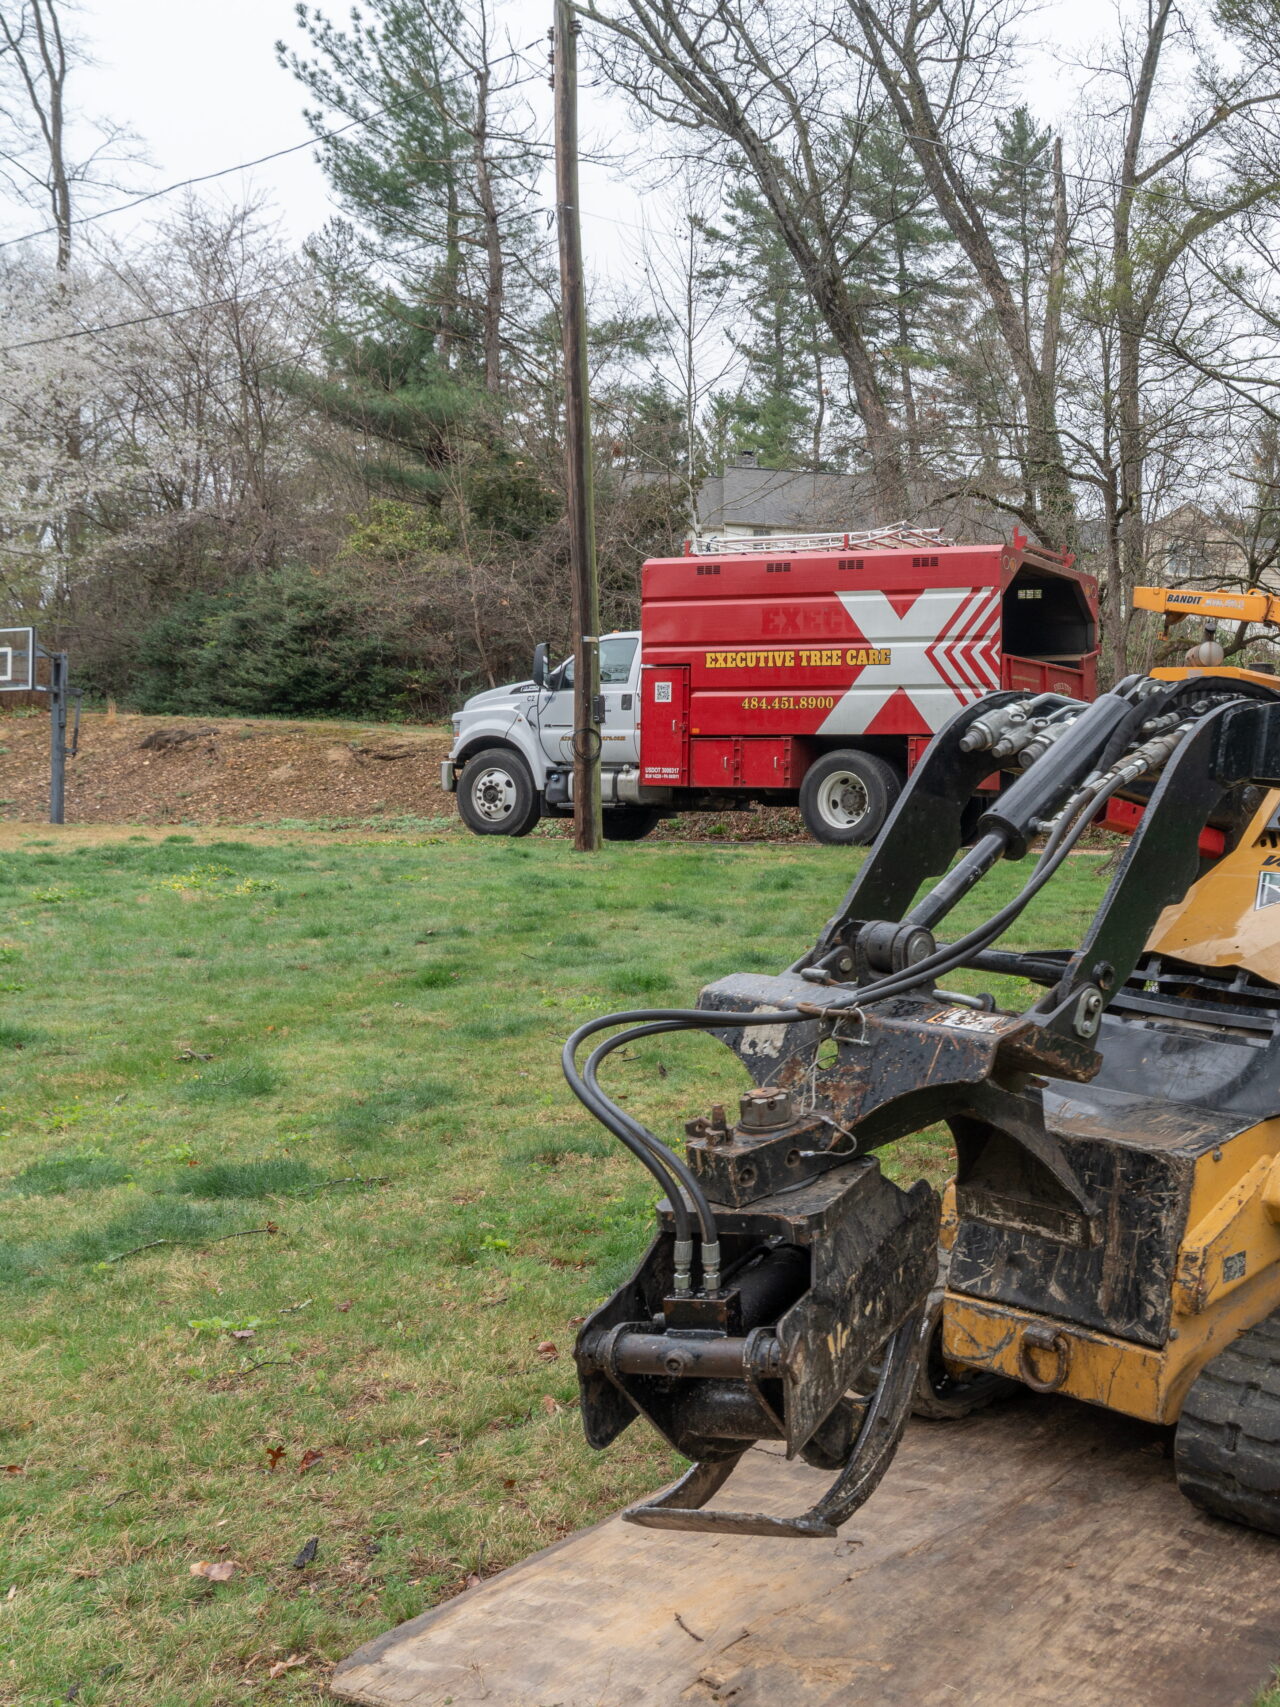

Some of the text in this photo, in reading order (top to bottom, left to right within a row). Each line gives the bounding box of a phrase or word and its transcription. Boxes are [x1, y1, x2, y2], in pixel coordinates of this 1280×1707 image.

[1167, 594, 1202, 605] BANDIT
[705, 648, 892, 669] EXECUTIVE TREE CARE
[741, 696, 834, 710] 484.451.8900
